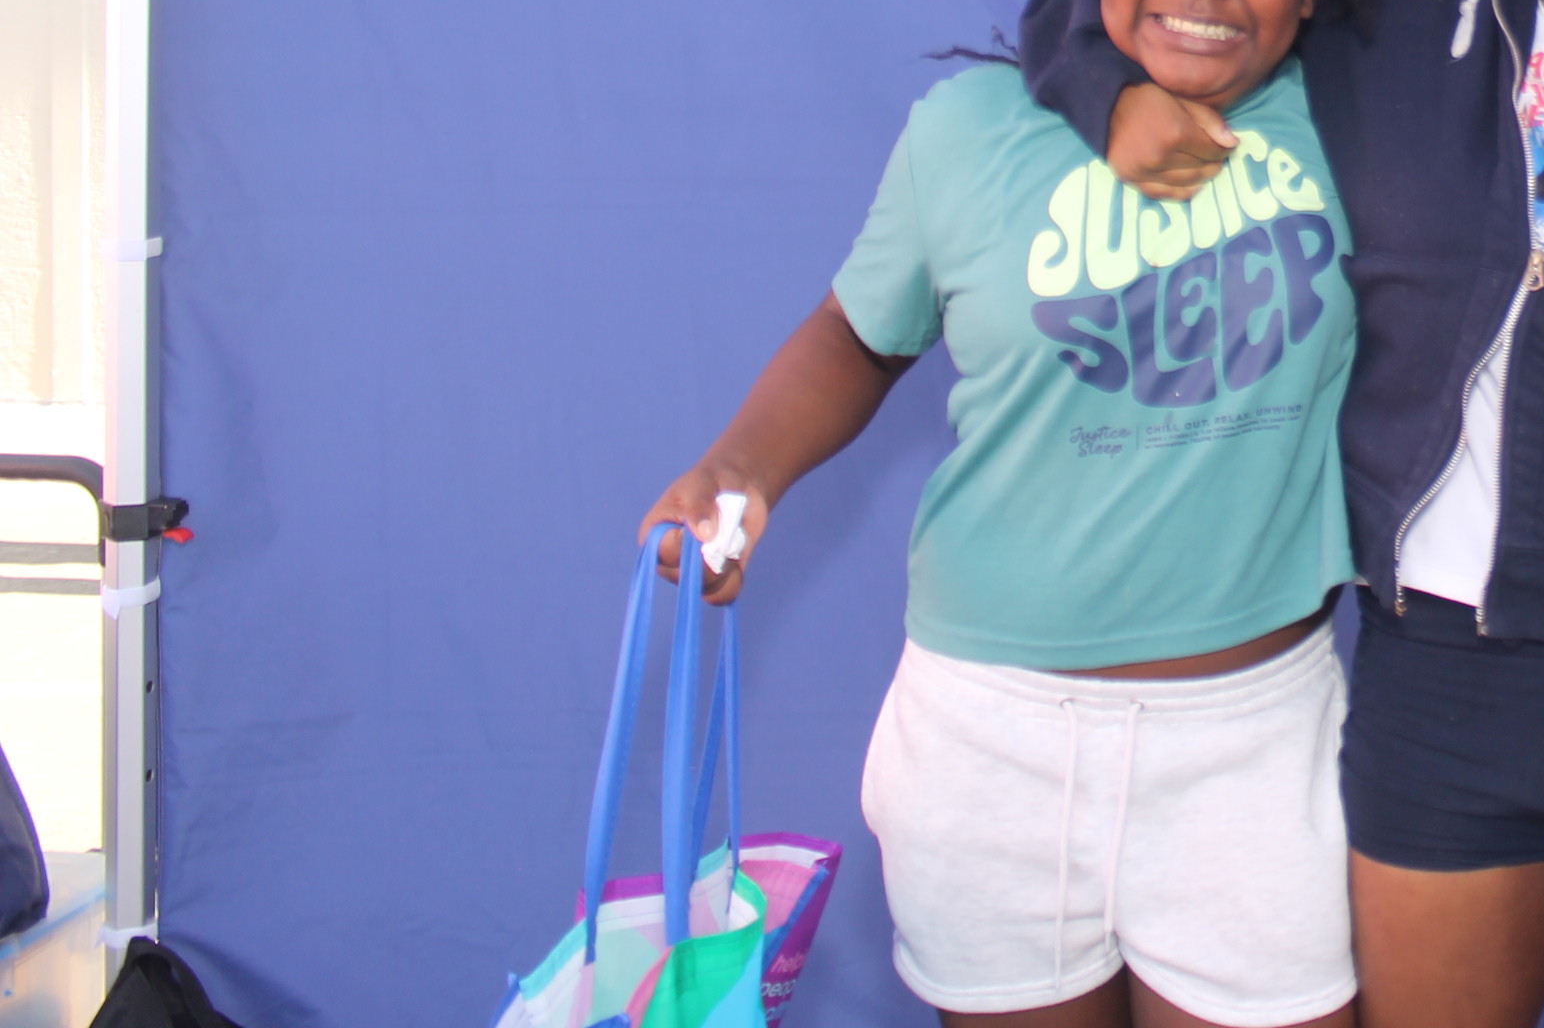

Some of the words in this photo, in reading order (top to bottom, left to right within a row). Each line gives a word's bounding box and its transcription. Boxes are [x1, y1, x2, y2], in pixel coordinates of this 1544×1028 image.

[1030, 213, 1336, 409] SLEEP
[1145, 423, 1180, 436] CHILL
[1256, 404, 1303, 416] UNWIND
[1069, 425, 1132, 445] Justice
[1077, 440, 1123, 460] Sleep
